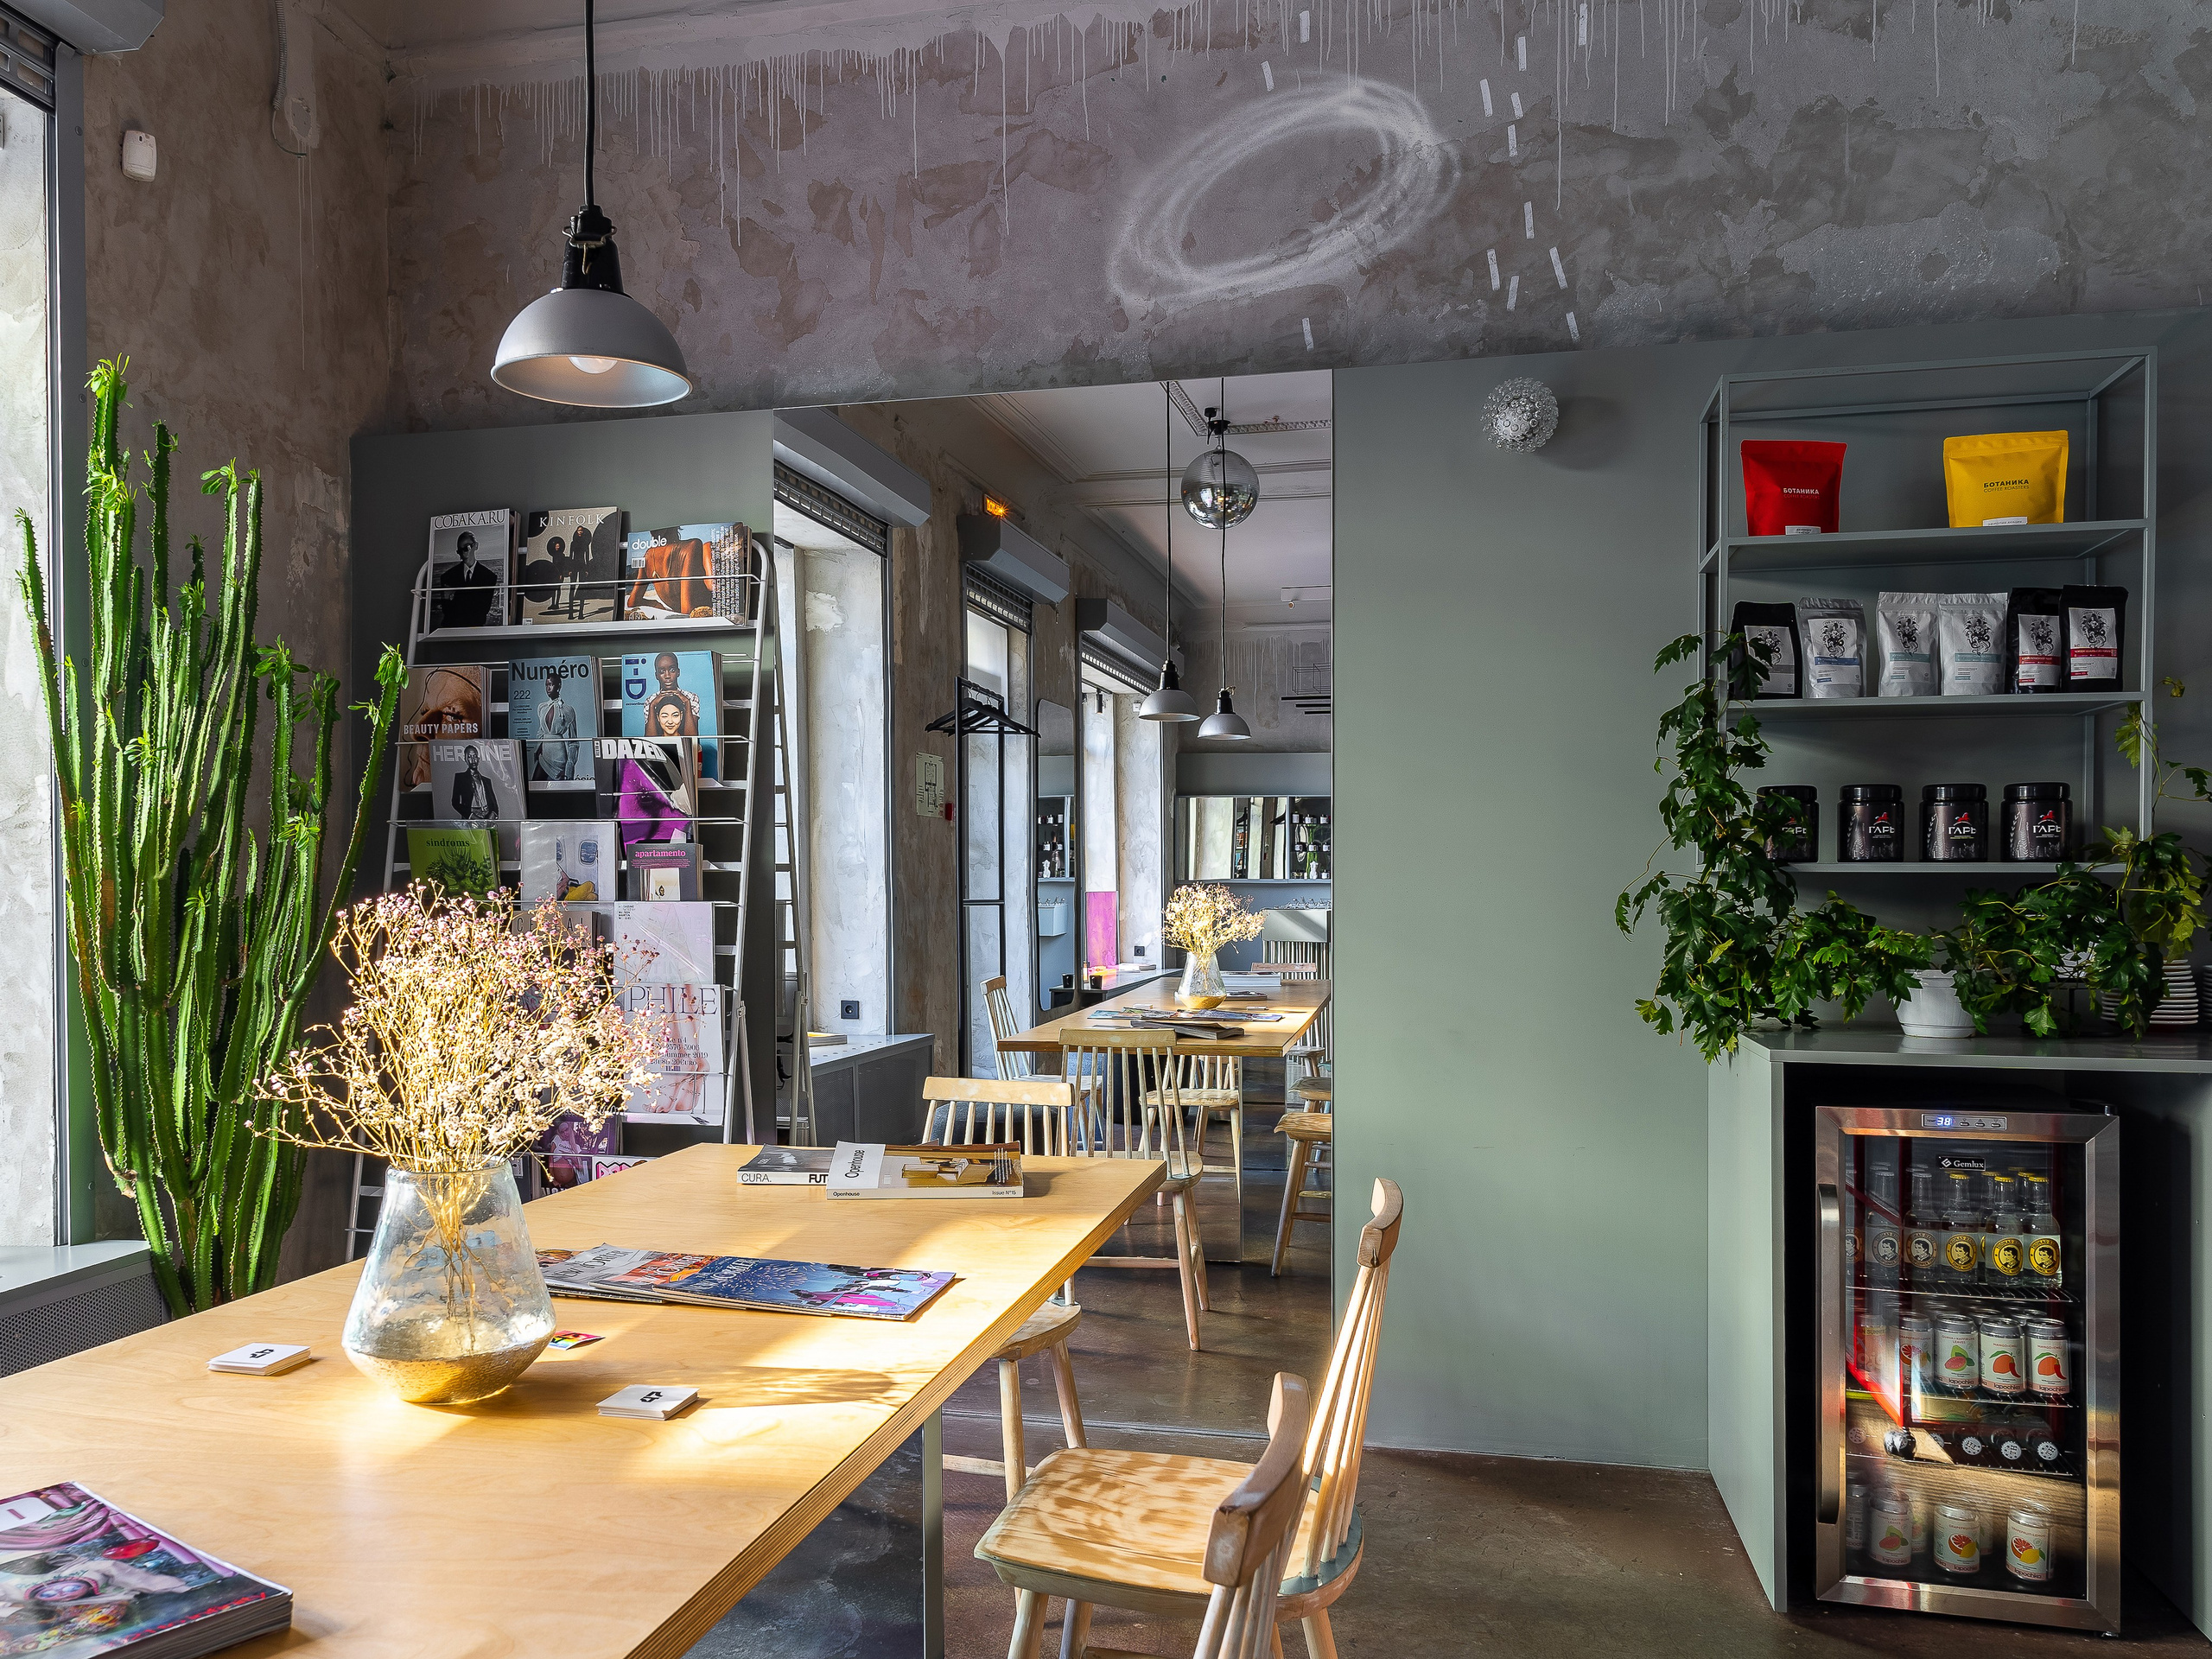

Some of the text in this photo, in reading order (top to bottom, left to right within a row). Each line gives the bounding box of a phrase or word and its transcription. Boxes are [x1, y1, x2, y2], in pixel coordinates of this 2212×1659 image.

[1983, 479, 2030, 488] БОТАНИКА
[539, 513, 605, 527] KINFOLK
[632, 535, 667, 550] double
[512, 659, 589, 681] Numéro
[513, 690, 531, 700] 222
[404, 722, 479, 734] BEAUTY PAPERS
[433, 744, 512, 762] HERINE
[601, 739, 668, 763] DAZED
[1948, 826, 1977, 835] ГАРЬ
[2032, 825, 2062, 834] ГАРЬ
[426, 838, 470, 847] sindroms
[634, 849, 686, 859] apartamento
[624, 986, 718, 1015] PHILE
[1936, 1116, 1952, 1126] 38
[844, 1149, 866, 1179] Openhouse
[1953, 1160, 1984, 1168] Gemlux
[741, 1173, 772, 1183] CURA.
[2014, 1567, 2042, 1579] lapochka
